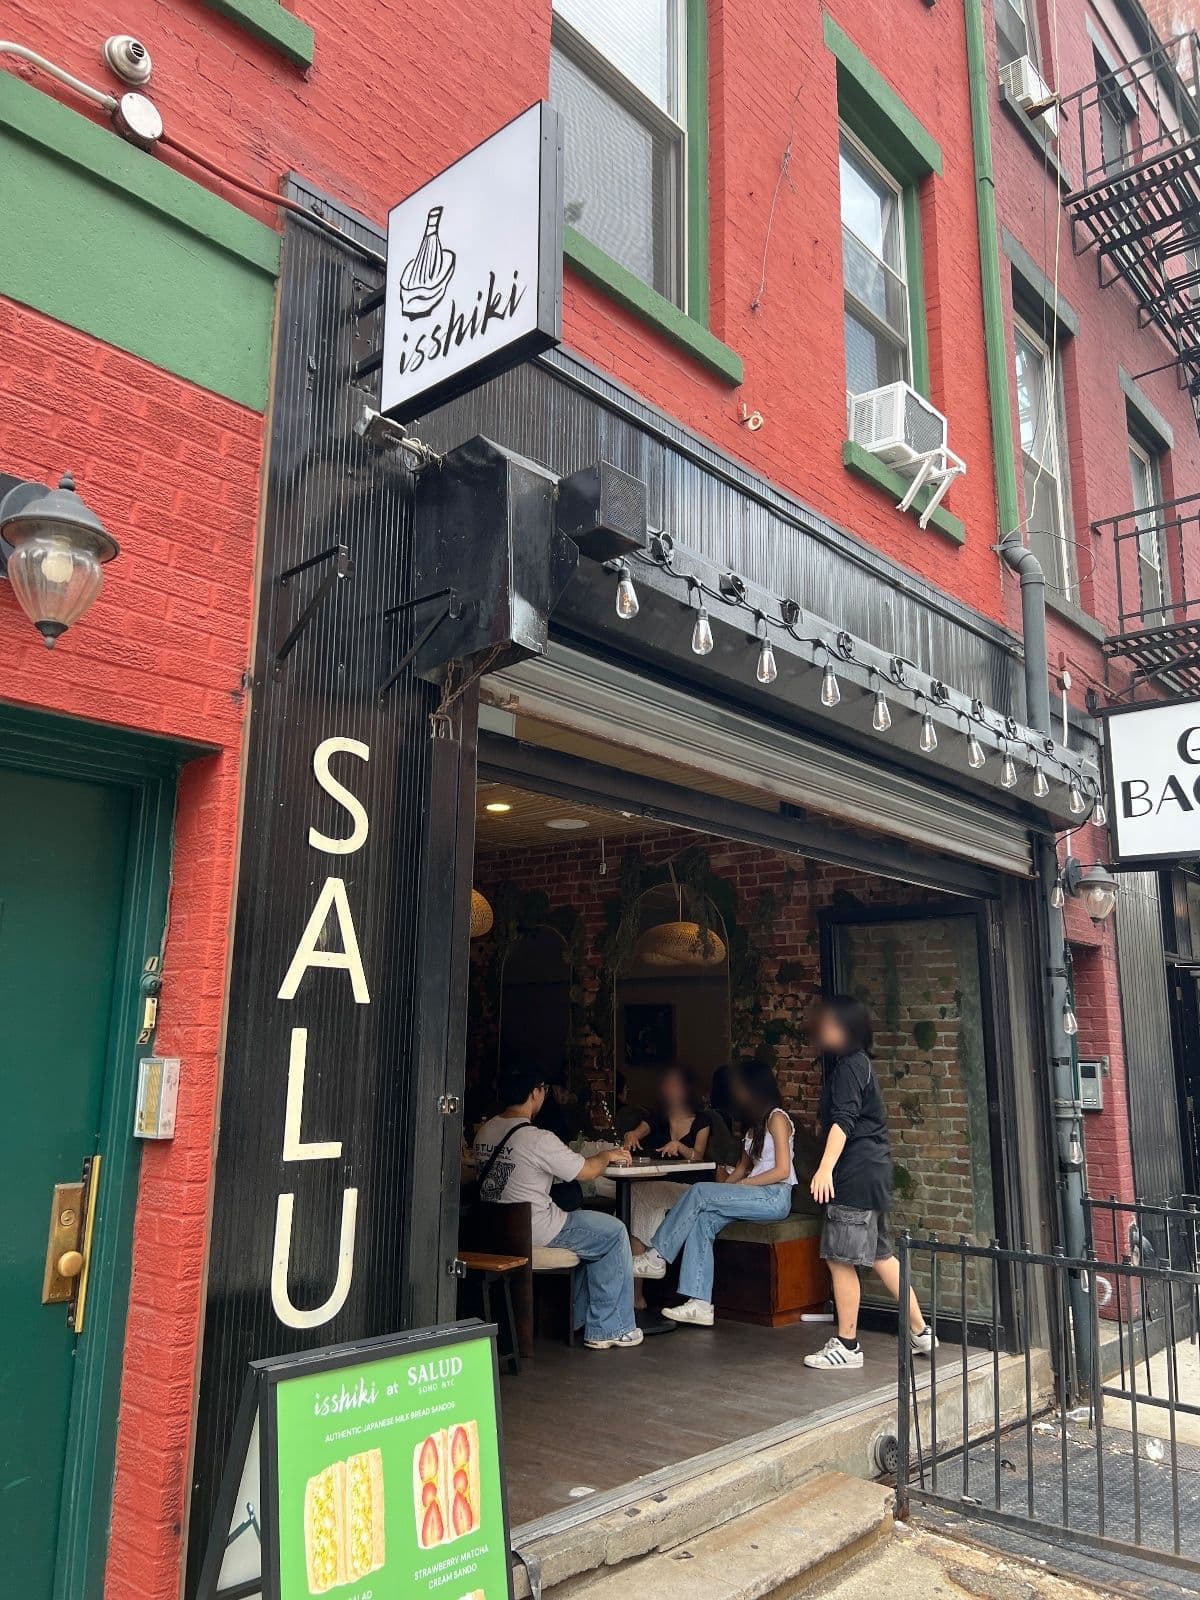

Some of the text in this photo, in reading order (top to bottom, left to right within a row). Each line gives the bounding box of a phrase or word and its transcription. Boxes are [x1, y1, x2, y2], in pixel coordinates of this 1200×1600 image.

[400, 270, 527, 375] isshiki
[314, 1356, 463, 1416] isshiki at SALUD
[418, 1378, 455, 1395] SOHO NYC
[325, 1401, 456, 1442] AUTHENTIC JAPANESE MILK BREAD SANDOS
[414, 1544, 489, 1581] STRAWBERRY MATCHA
[428, 1562, 478, 1590] CREAM SANDO
